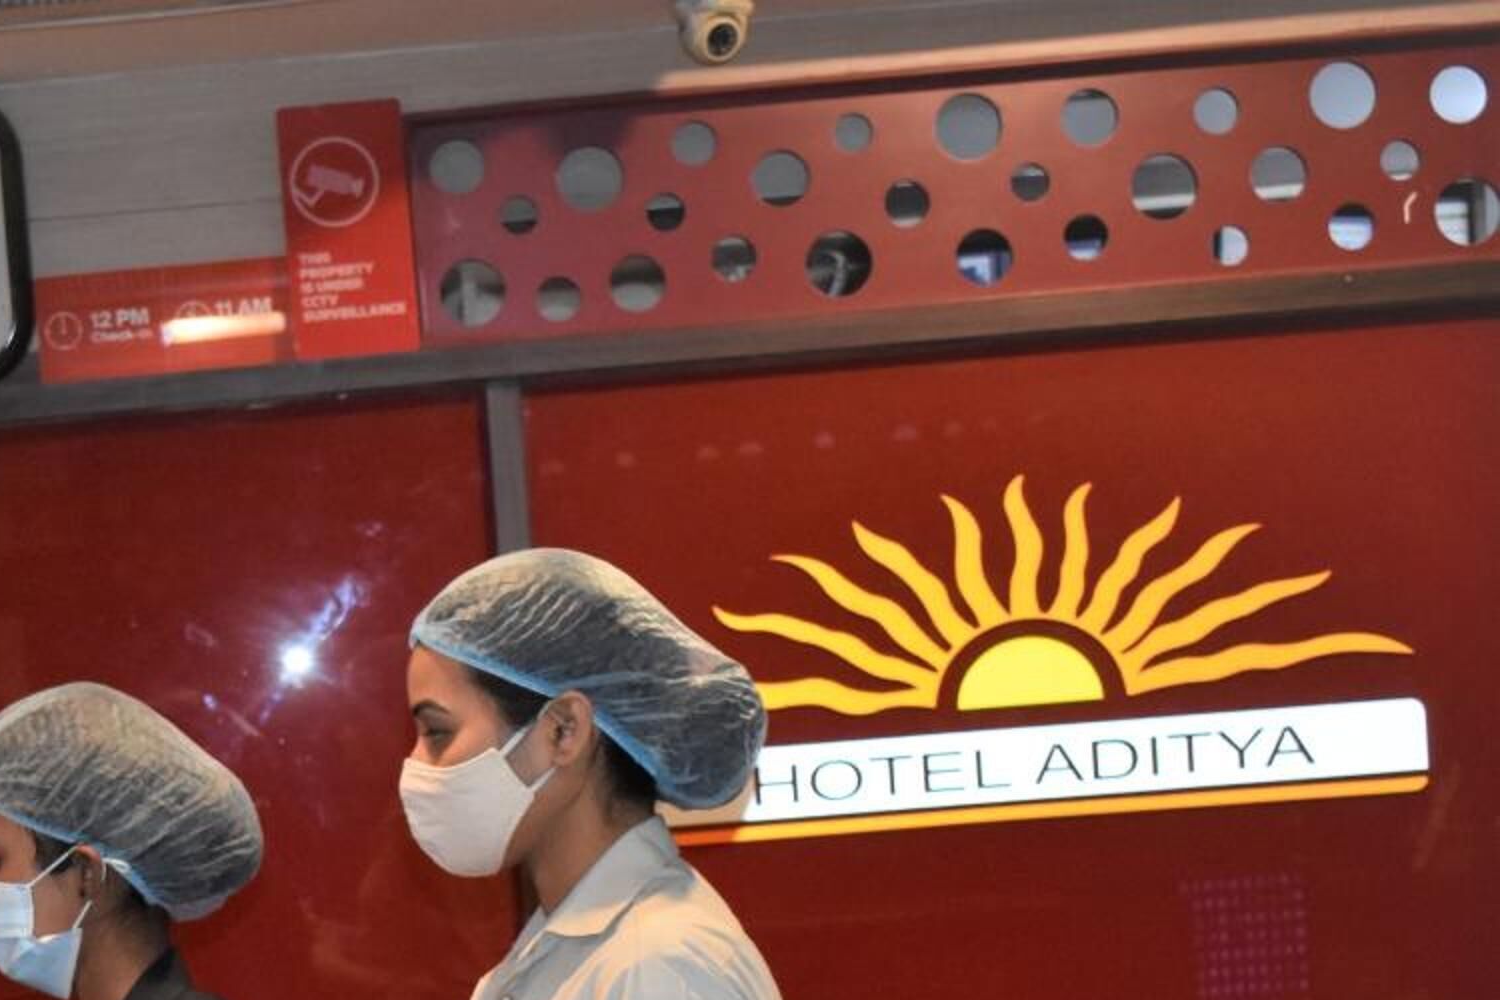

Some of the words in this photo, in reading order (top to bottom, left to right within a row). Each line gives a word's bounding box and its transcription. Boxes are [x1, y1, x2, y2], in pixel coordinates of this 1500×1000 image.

[90, 310, 113, 329] 12
[115, 307, 149, 327] PM
[753, 749, 1012, 805] HOTEL
[1035, 726, 1315, 785] ADITYA
